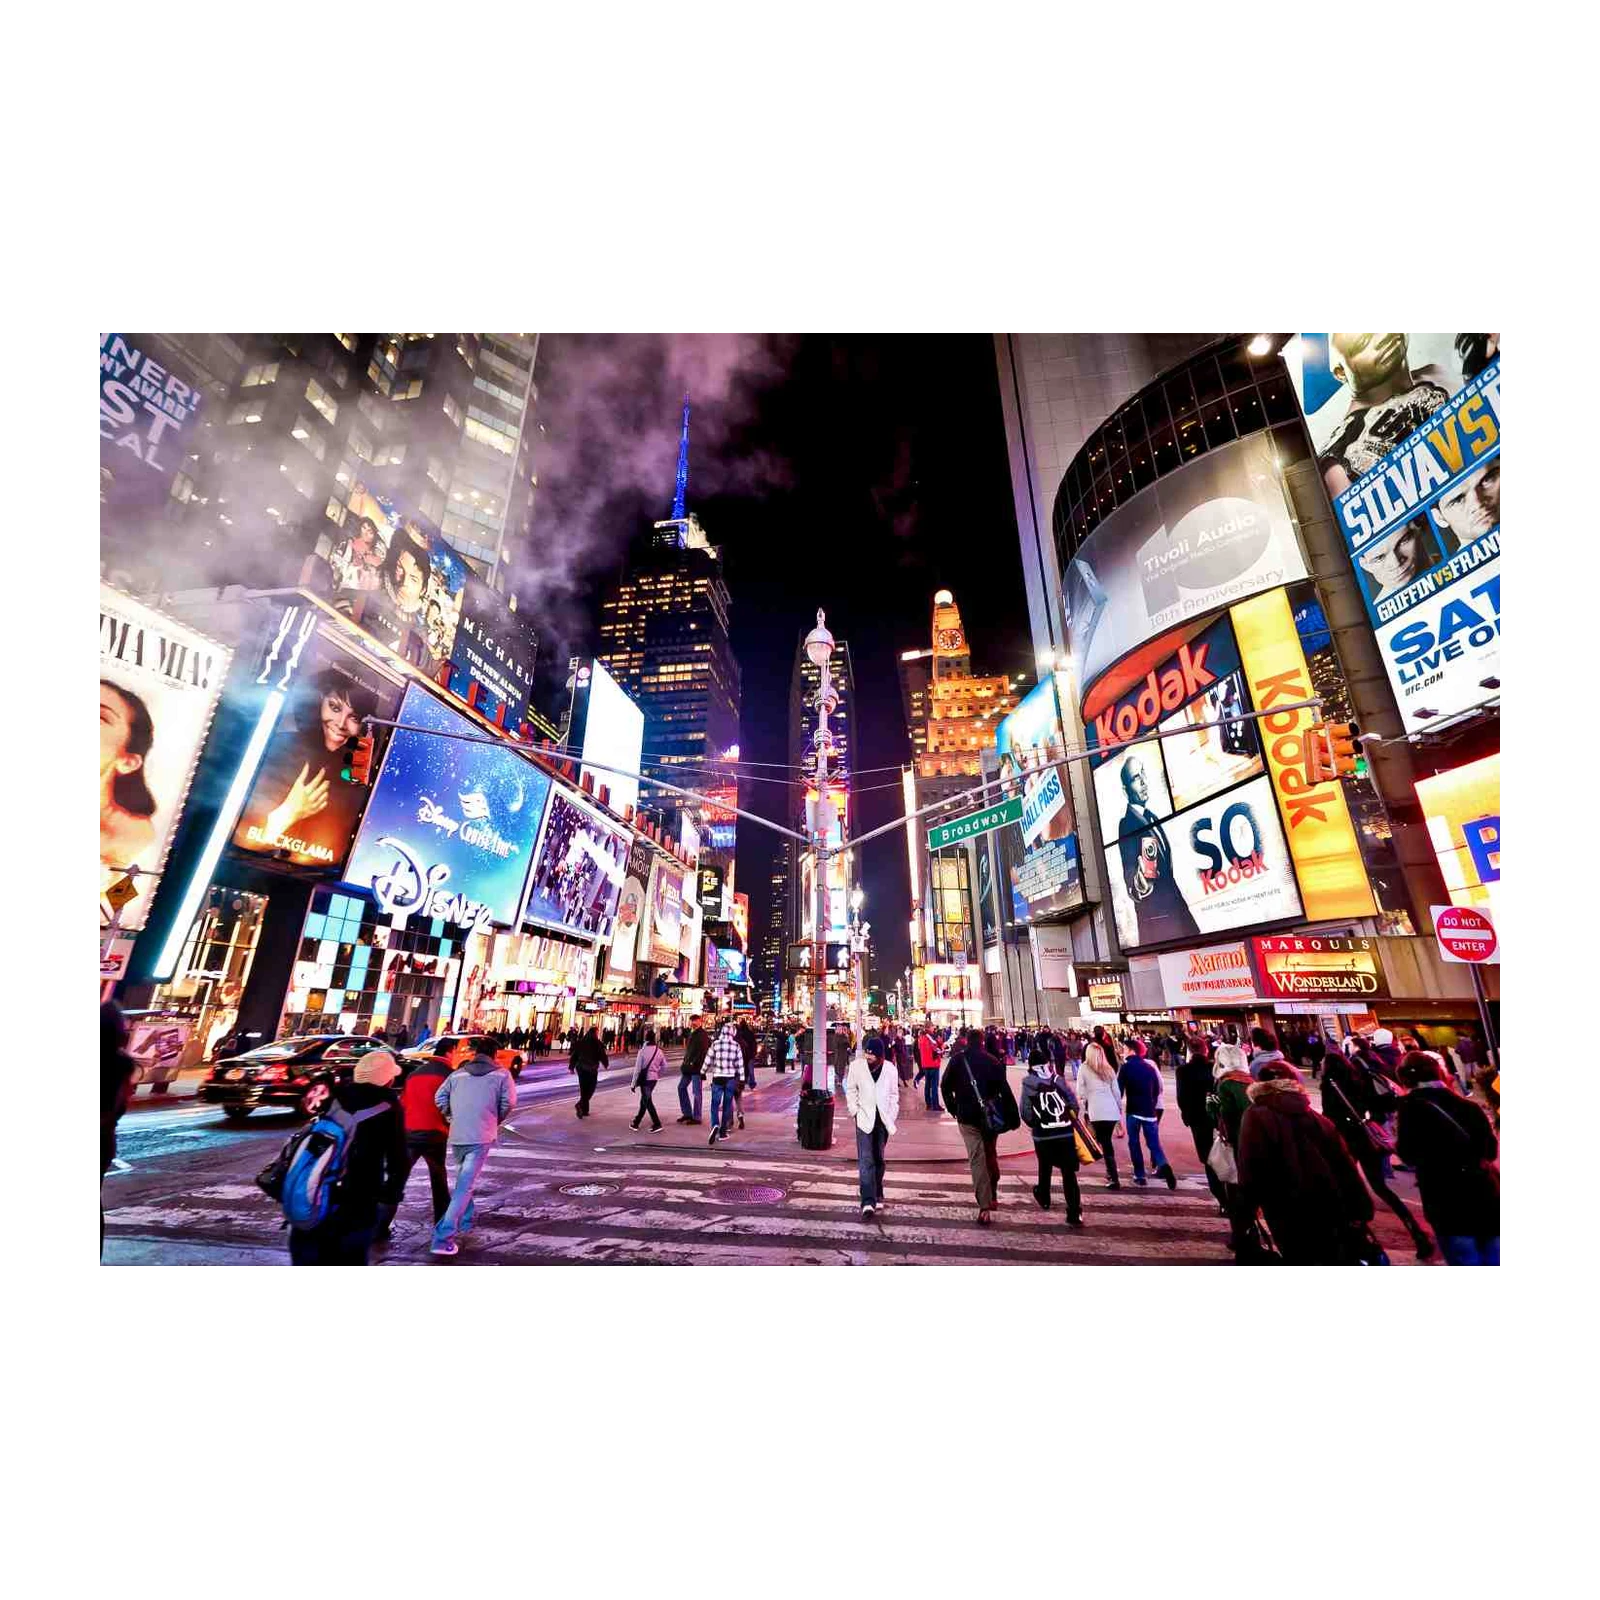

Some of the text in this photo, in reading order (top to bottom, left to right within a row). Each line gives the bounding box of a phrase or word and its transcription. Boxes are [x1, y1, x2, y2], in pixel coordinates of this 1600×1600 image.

[1339, 462, 1389, 504] WORLD
[1343, 440, 1449, 548] SILVA
[1427, 394, 1499, 475] VS
[1144, 514, 1256, 572] Tivoli Audio
[1183, 567, 1285, 614] Anniversary
[1377, 577, 1436, 623] GRIFFIN
[1433, 566, 1454, 587] VS
[151, 636, 213, 689] MIA!
[464, 617, 535, 686] MICHAEL
[466, 647, 482, 668] THE
[483, 662, 501, 682] NEW
[1398, 620, 1500, 685] LIVE O
[1095, 643, 1217, 746] Kodak
[1405, 671, 1444, 697] UFC.COM
[1255, 667, 1337, 828] Kodak
[942, 808, 1008, 841] Broadway
[1020, 774, 1061, 834] HALL PASS
[1190, 801, 1262, 879] SO
[1200, 850, 1270, 896] Kodak
[1261, 939, 1371, 951] MARQUIS
[1443, 917, 1482, 928] DO NOT
[1452, 941, 1487, 953] ENTER
[1271, 972, 1378, 994] WONDERLAND
